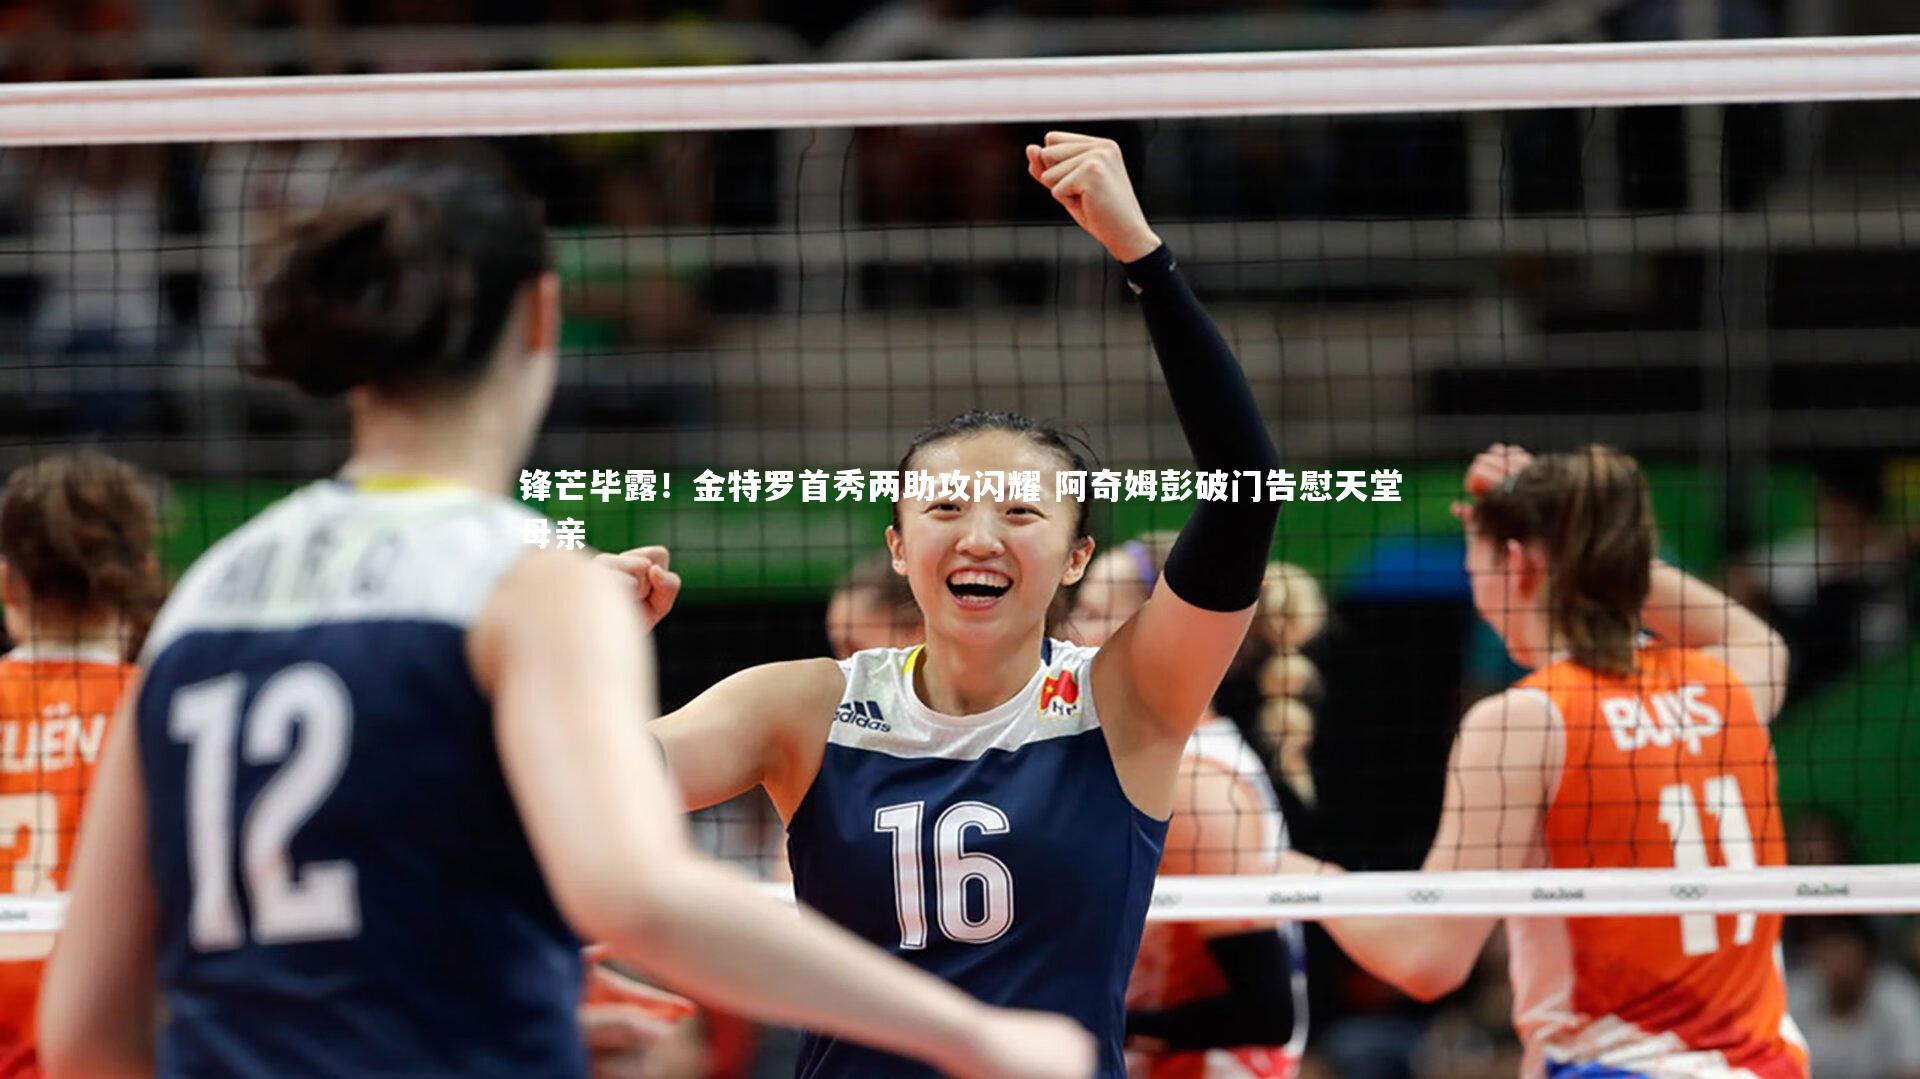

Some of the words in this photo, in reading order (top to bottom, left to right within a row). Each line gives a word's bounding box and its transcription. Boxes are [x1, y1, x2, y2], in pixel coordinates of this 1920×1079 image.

[167, 661, 362, 952] 12
[874, 801, 1014, 949] 16
[1658, 774, 1757, 956] 11
